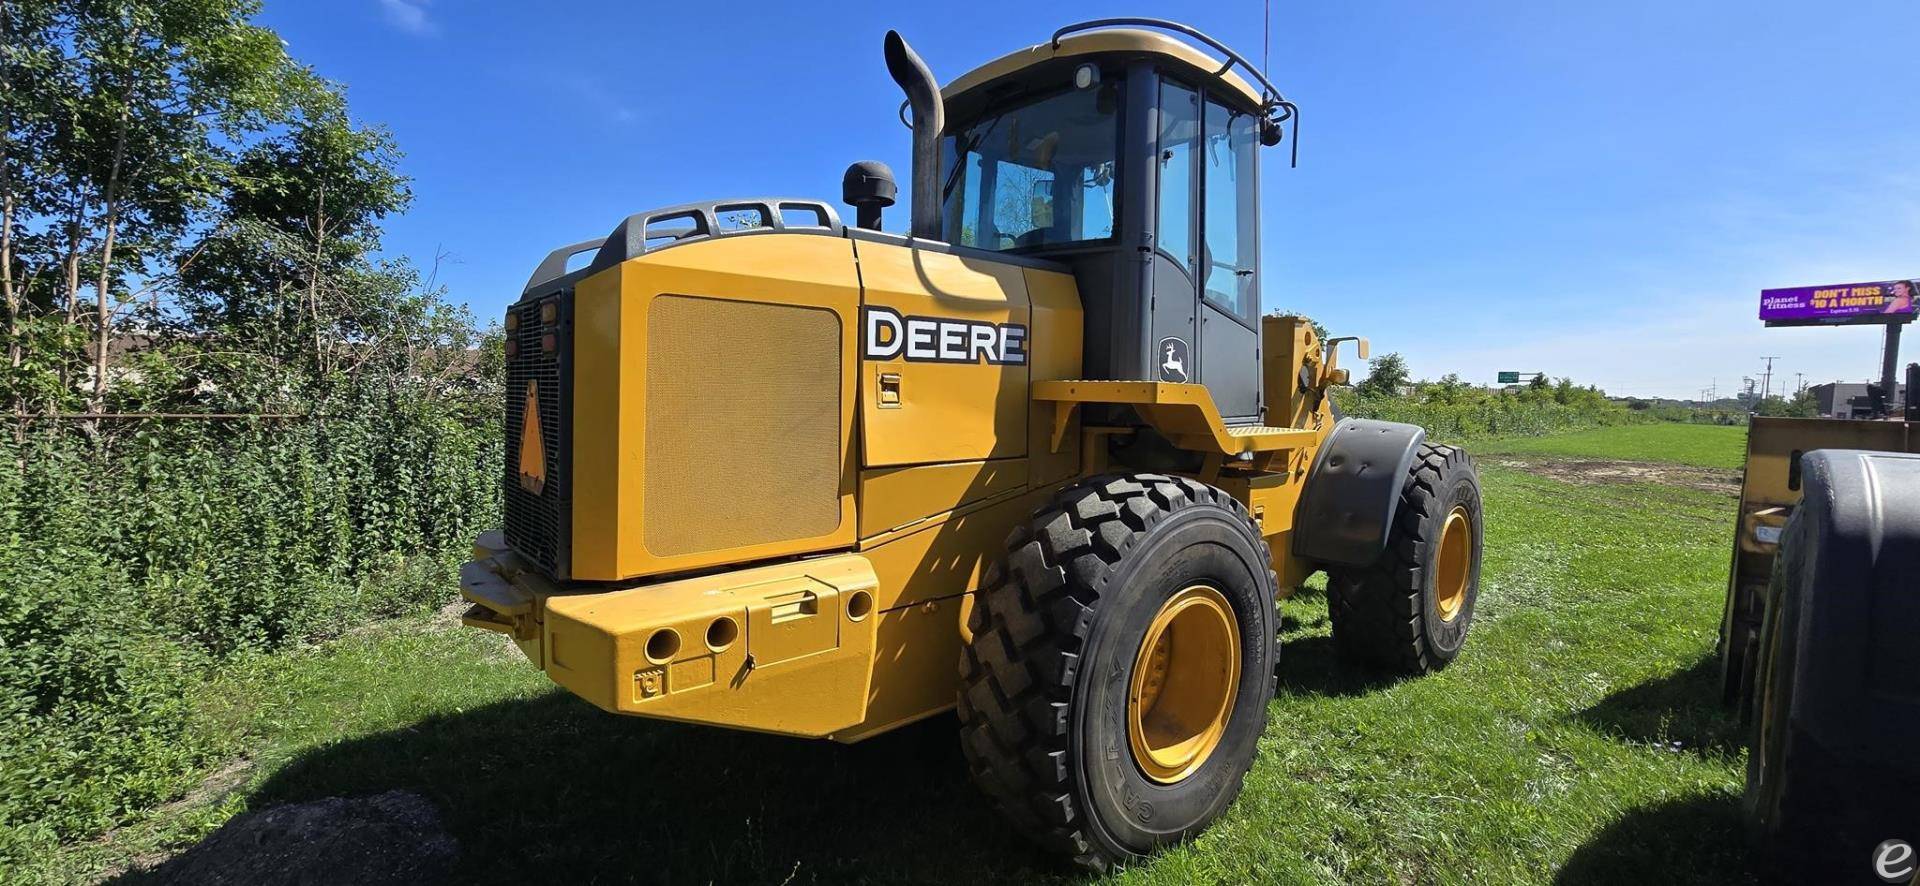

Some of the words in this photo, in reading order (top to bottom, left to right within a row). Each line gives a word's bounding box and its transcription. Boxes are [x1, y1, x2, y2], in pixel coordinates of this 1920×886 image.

[1814, 289, 1849, 299] DON'T
[1851, 287, 1881, 296] MISS
[1763, 296, 1798, 306] planet
[1767, 302, 1805, 310] fitness
[1830, 298, 1838, 308] A
[1840, 296, 1883, 307] MONTH
[866, 309, 1025, 363] DEERE
